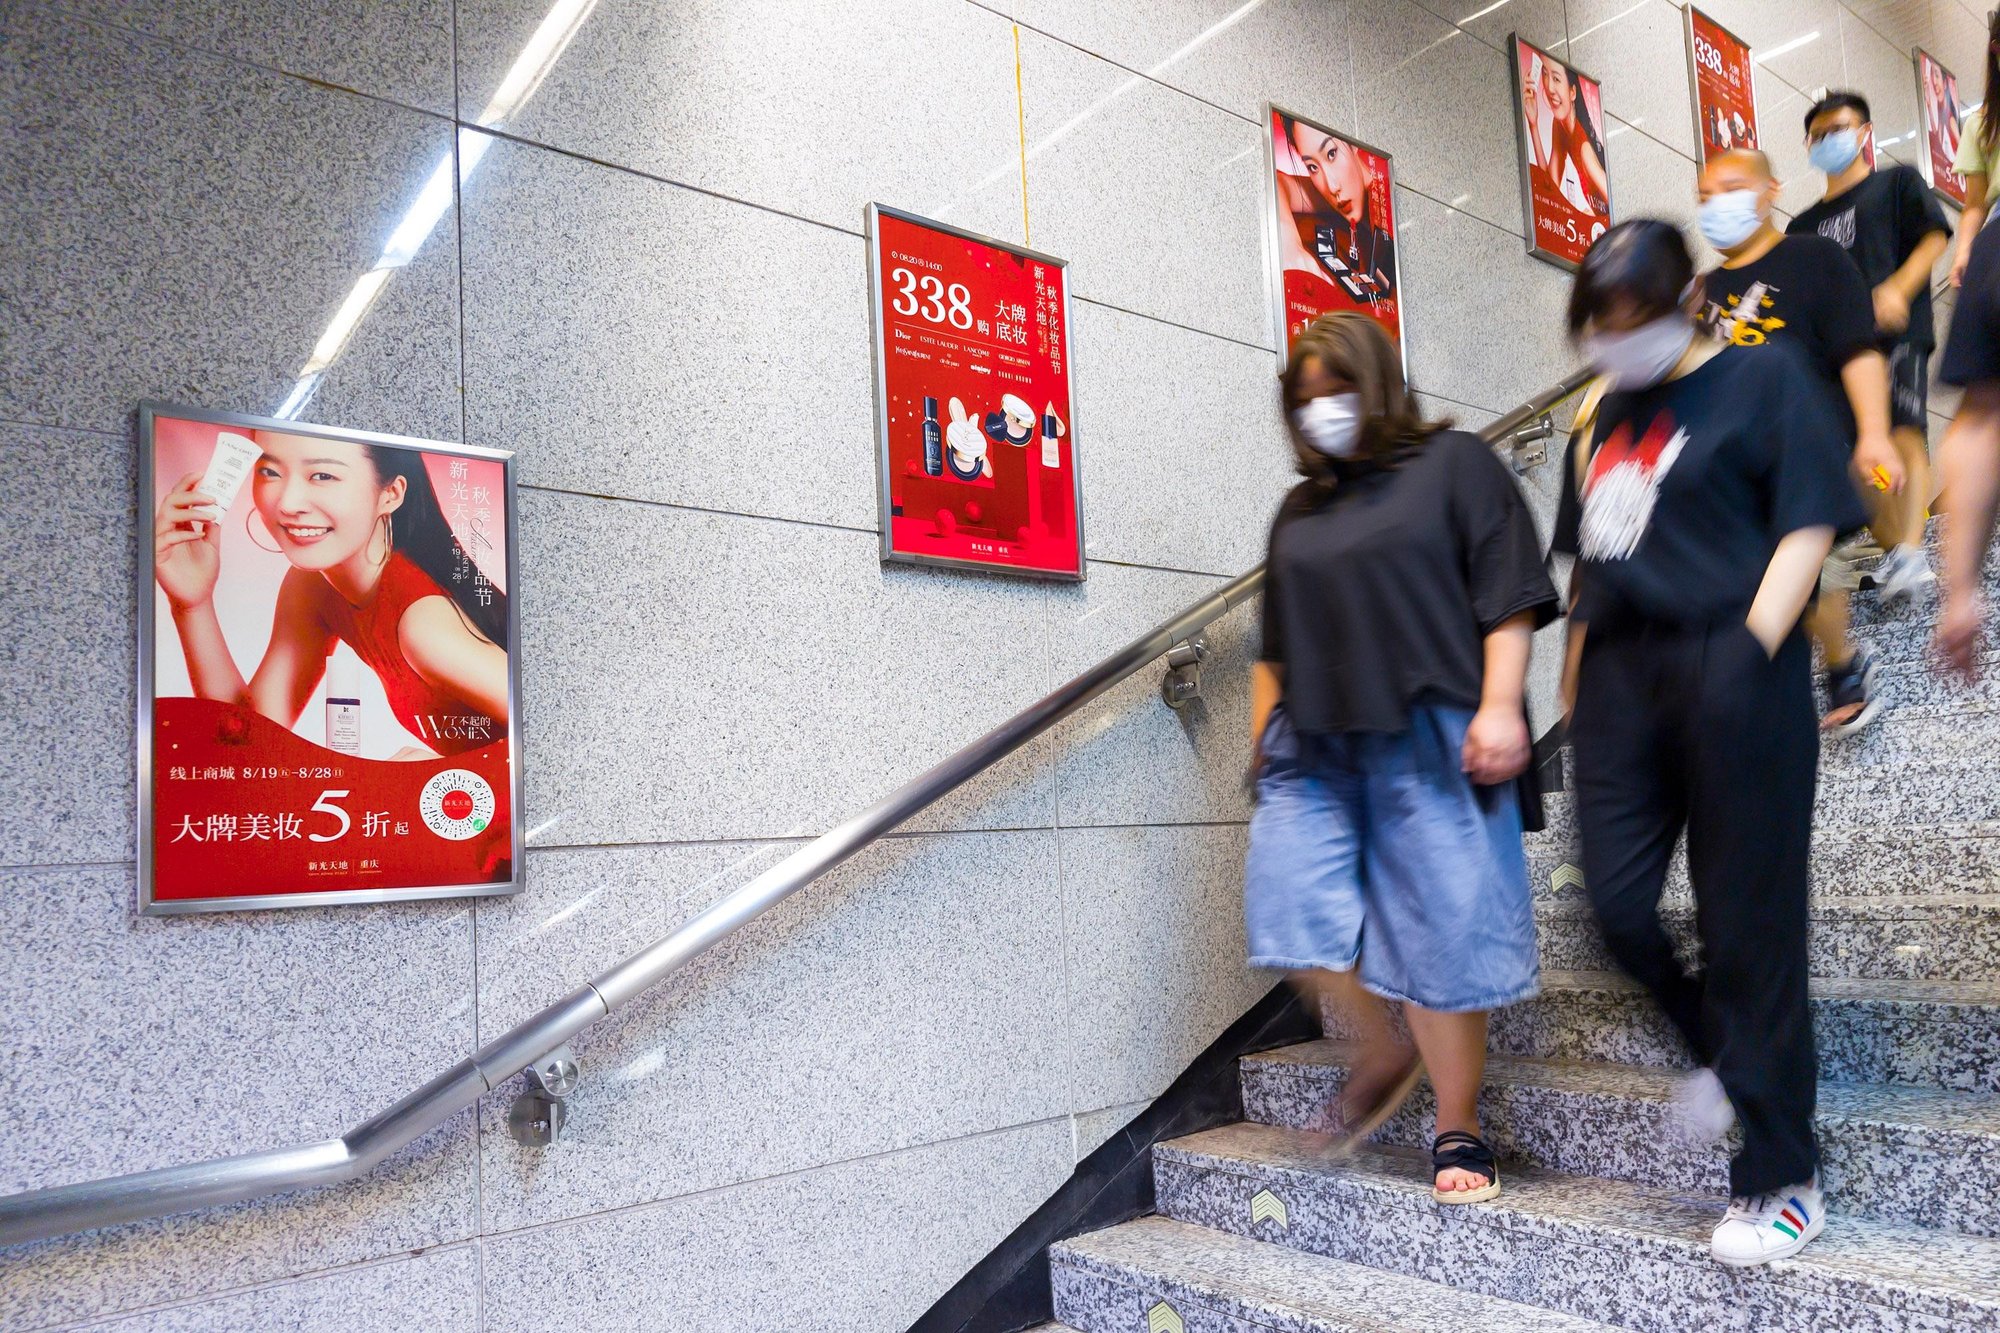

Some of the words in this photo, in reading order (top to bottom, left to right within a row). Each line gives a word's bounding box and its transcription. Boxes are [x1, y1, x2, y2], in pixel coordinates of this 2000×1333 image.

[1695, 36, 1723, 75] 338
[892, 267, 974, 330] 338
[1034, 265, 1047, 326] 新光天地
[994, 300, 1027, 325] 大牌
[894, 328, 912, 341] Dior
[995, 321, 1028, 347] 底妆
[1047, 285, 1062, 375] 秋季化妆品节
[449, 461, 469, 541] 新光天地
[414, 715, 490, 740] WOMEN
[448, 715, 491, 727] 了不起的
[170, 766, 236, 781] 线上商城
[308, 860, 349, 871] 新光天地
[360, 859, 379, 869] 重庆
